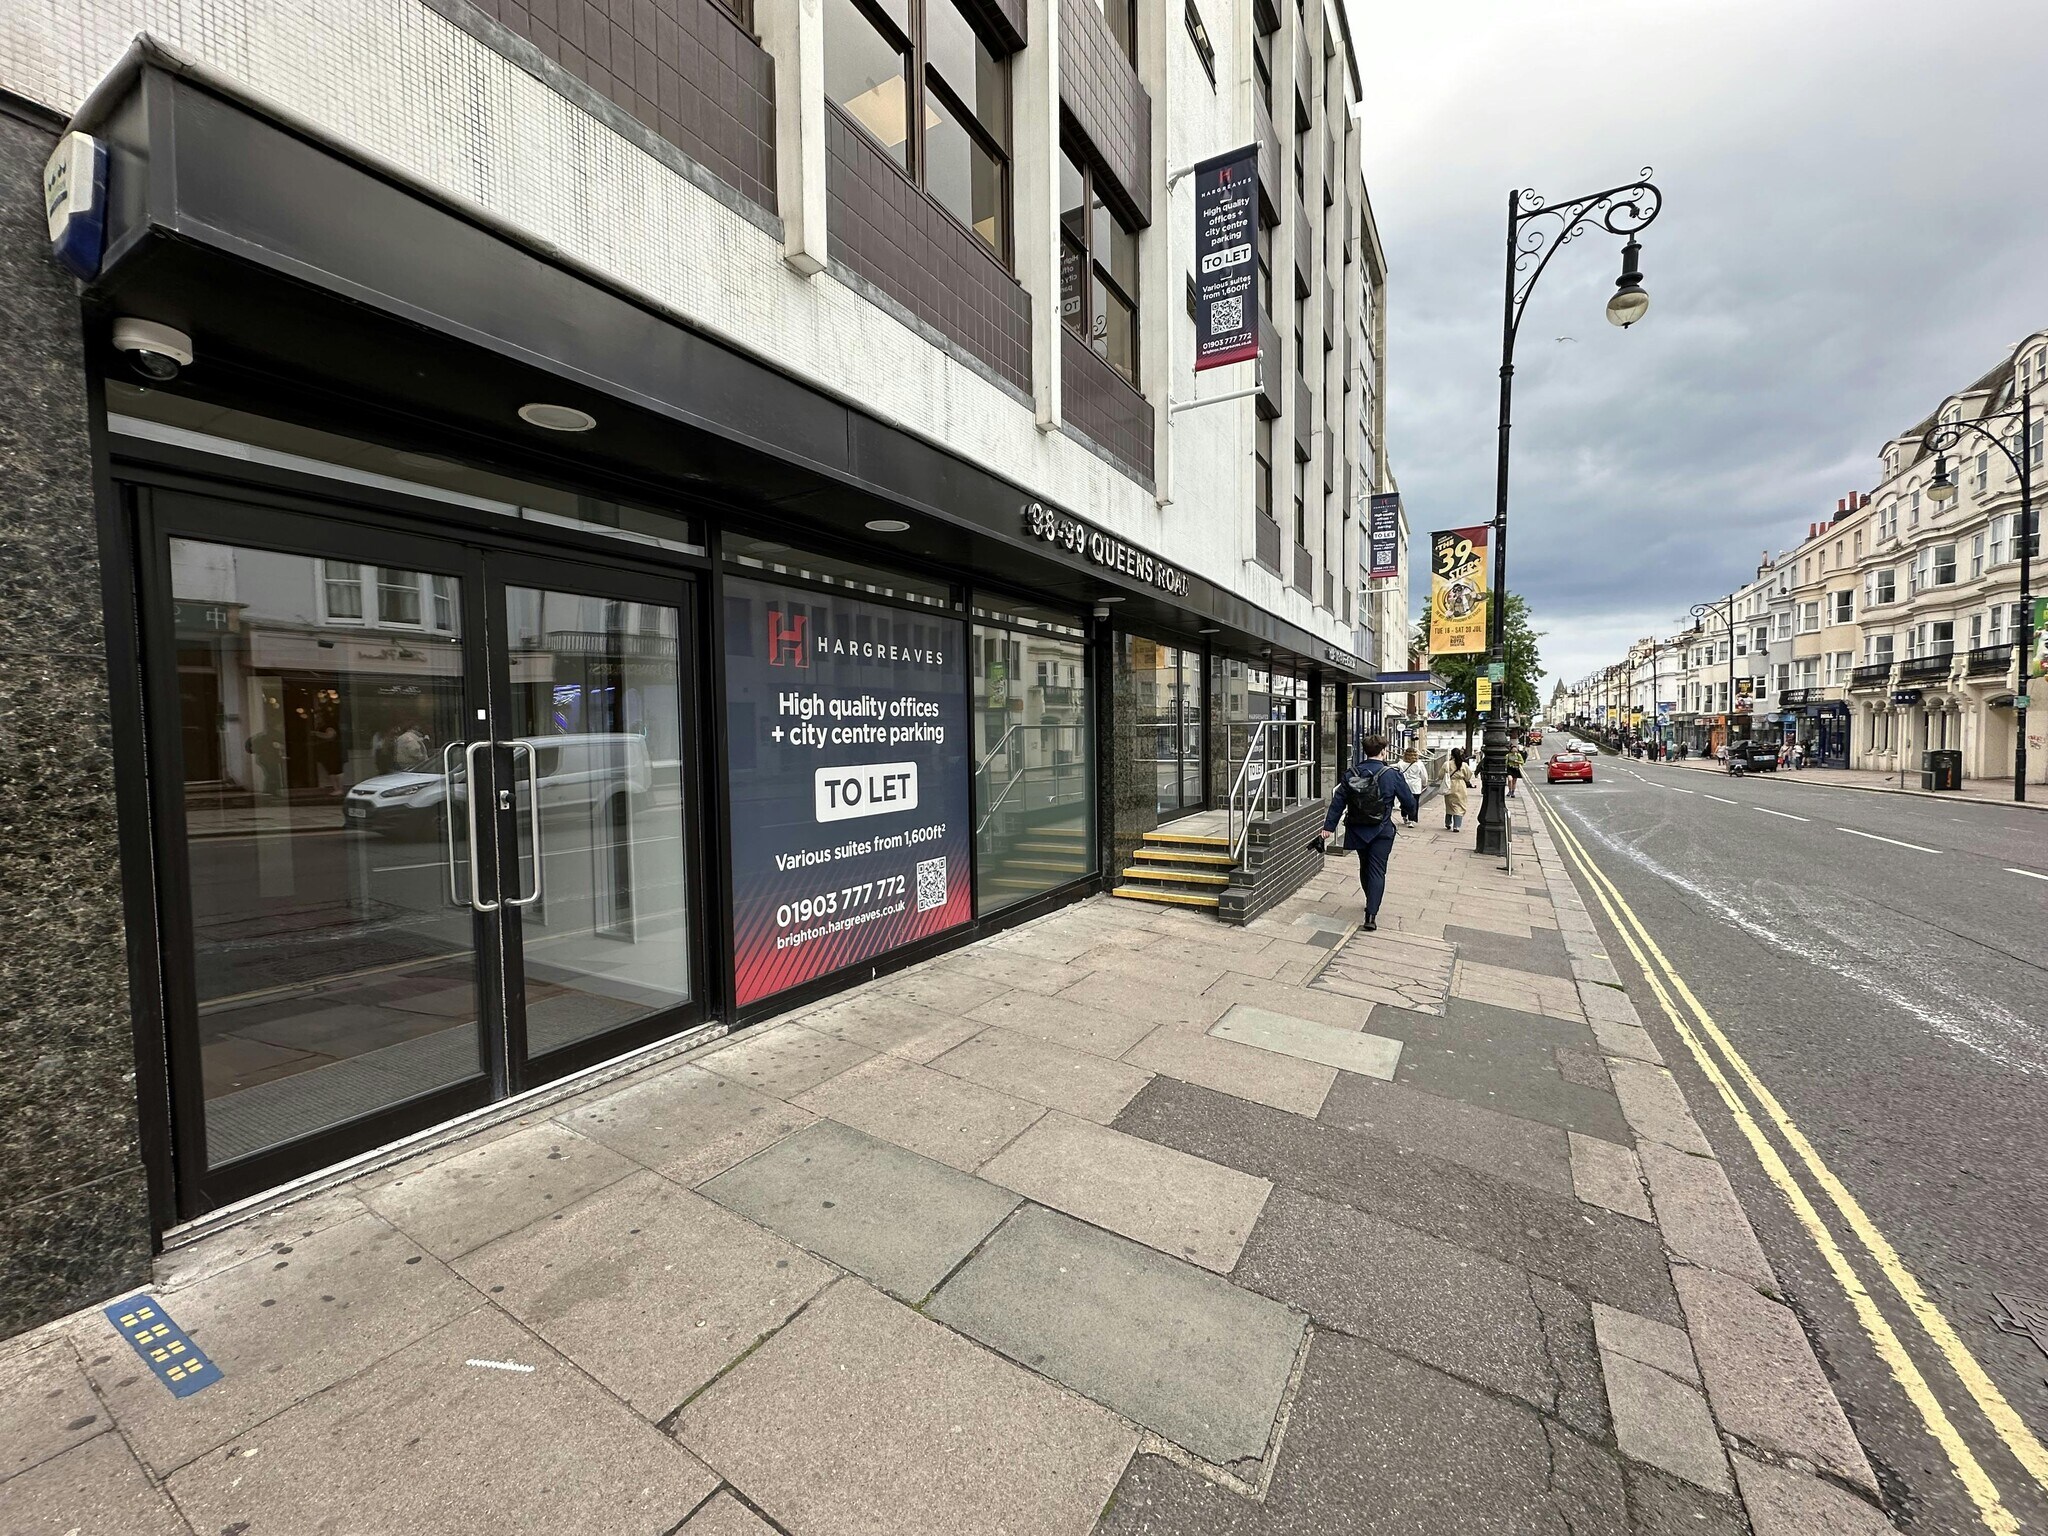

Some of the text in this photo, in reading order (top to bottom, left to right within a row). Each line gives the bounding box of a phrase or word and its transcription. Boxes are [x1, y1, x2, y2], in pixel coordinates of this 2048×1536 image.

[1201, 177, 1252, 198] HARGREAVES
[1203, 197, 1250, 217] High quality
[1205, 219, 1248, 237] city centre
[1209, 212, 1236, 225] offices
[1211, 231, 1242, 246] parking
[1204, 248, 1249, 270] TO LET
[1202, 275, 1252, 293] Various suites
[1203, 291, 1220, 301] from
[1202, 332, 1252, 350] 01903 777 772
[1029, 502, 1190, 597] 98-99 QUEENS ROAD
[1435, 538, 1454, 551] THE
[1438, 539, 1473, 574] 39
[1449, 557, 1482, 580] STEPS
[818, 636, 943, 665] HARGREAVES
[779, 692, 939, 720] High quality offices
[789, 722, 828, 748] city
[831, 724, 887, 743] centre
[890, 722, 944, 746] parking
[824, 773, 911, 808] TO LET
[775, 849, 832, 872] Various
[834, 841, 872, 860] suites
[874, 835, 903, 852] from
[776, 875, 906, 928] 01903 777 772
[777, 900, 906, 950] brighton.hargreaves.co.uk
